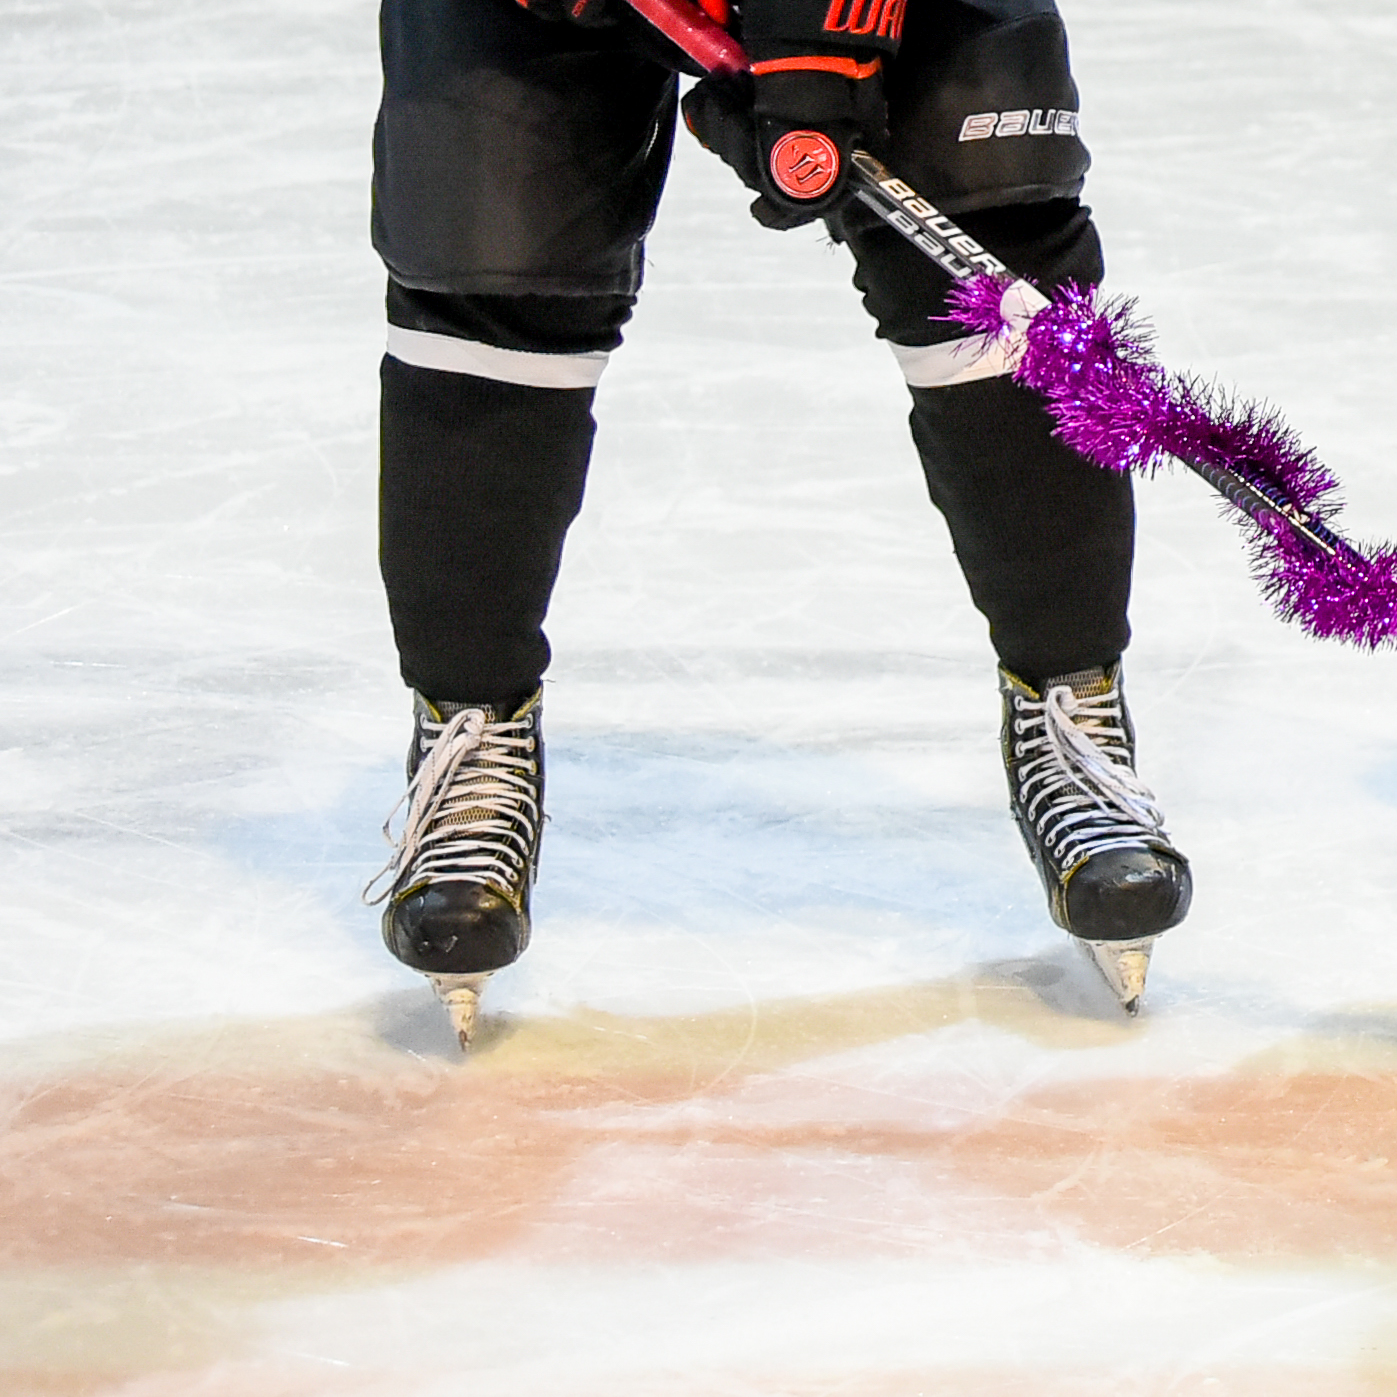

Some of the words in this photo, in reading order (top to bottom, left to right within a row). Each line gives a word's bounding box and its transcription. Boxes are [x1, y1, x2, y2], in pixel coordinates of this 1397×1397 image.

[959, 109, 1081, 142] BAUE
[879, 178, 1007, 276] BAUER
[886, 210, 972, 279] BAU
